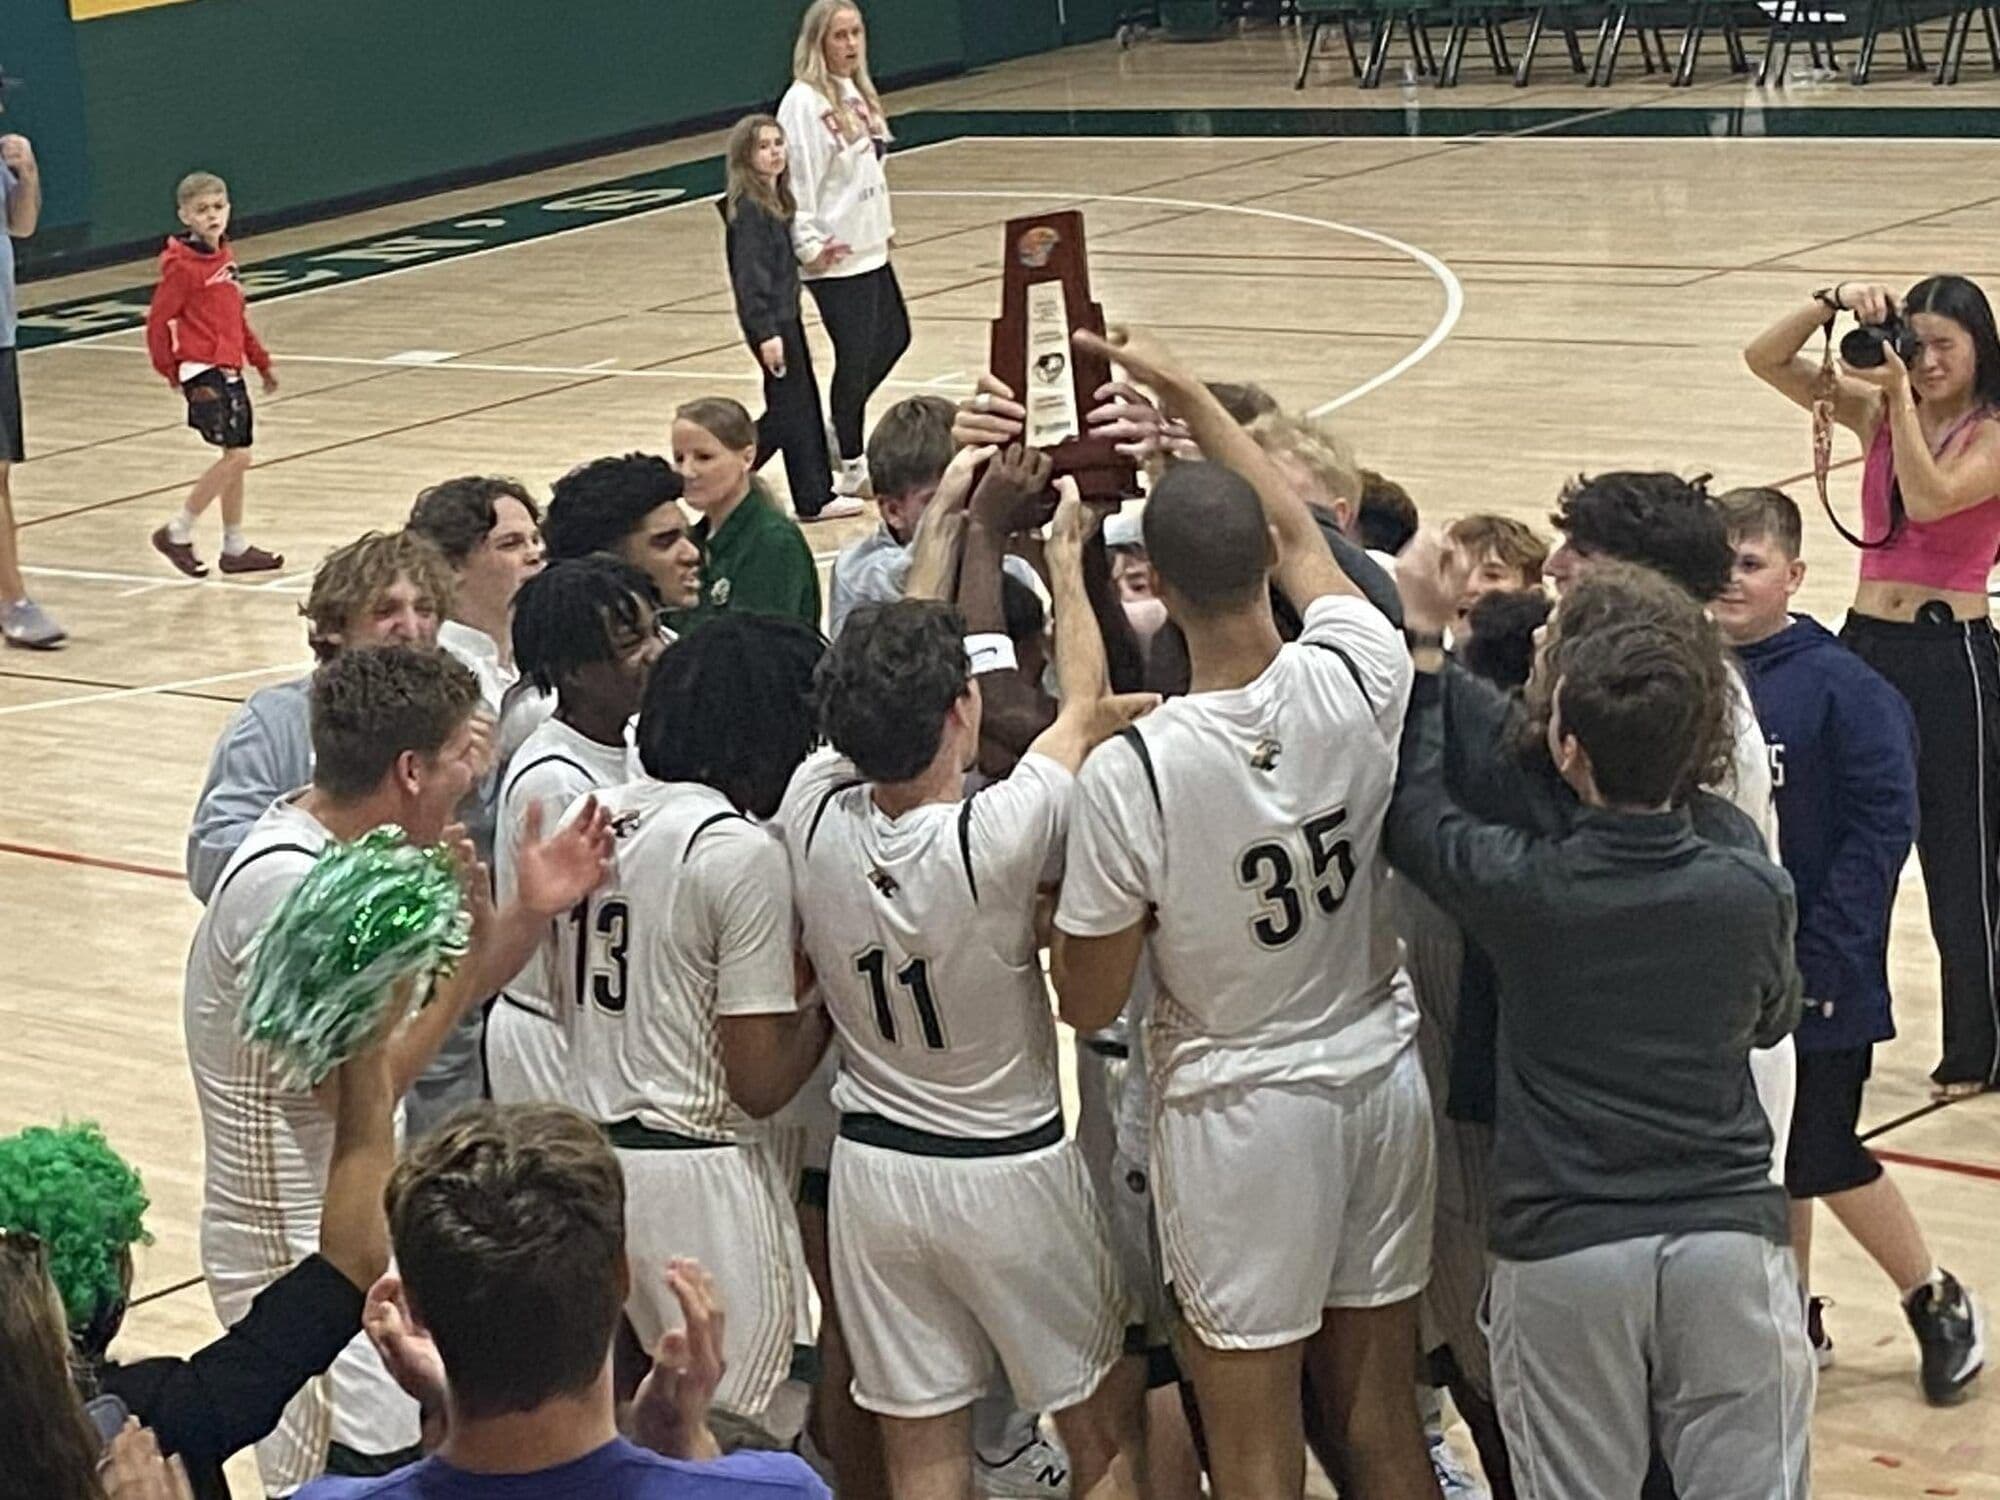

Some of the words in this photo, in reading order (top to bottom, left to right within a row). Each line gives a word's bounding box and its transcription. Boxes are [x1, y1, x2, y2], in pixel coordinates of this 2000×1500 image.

[1236, 806, 1358, 946] 35
[568, 896, 629, 1012] 13
[856, 947, 946, 1050] 11
